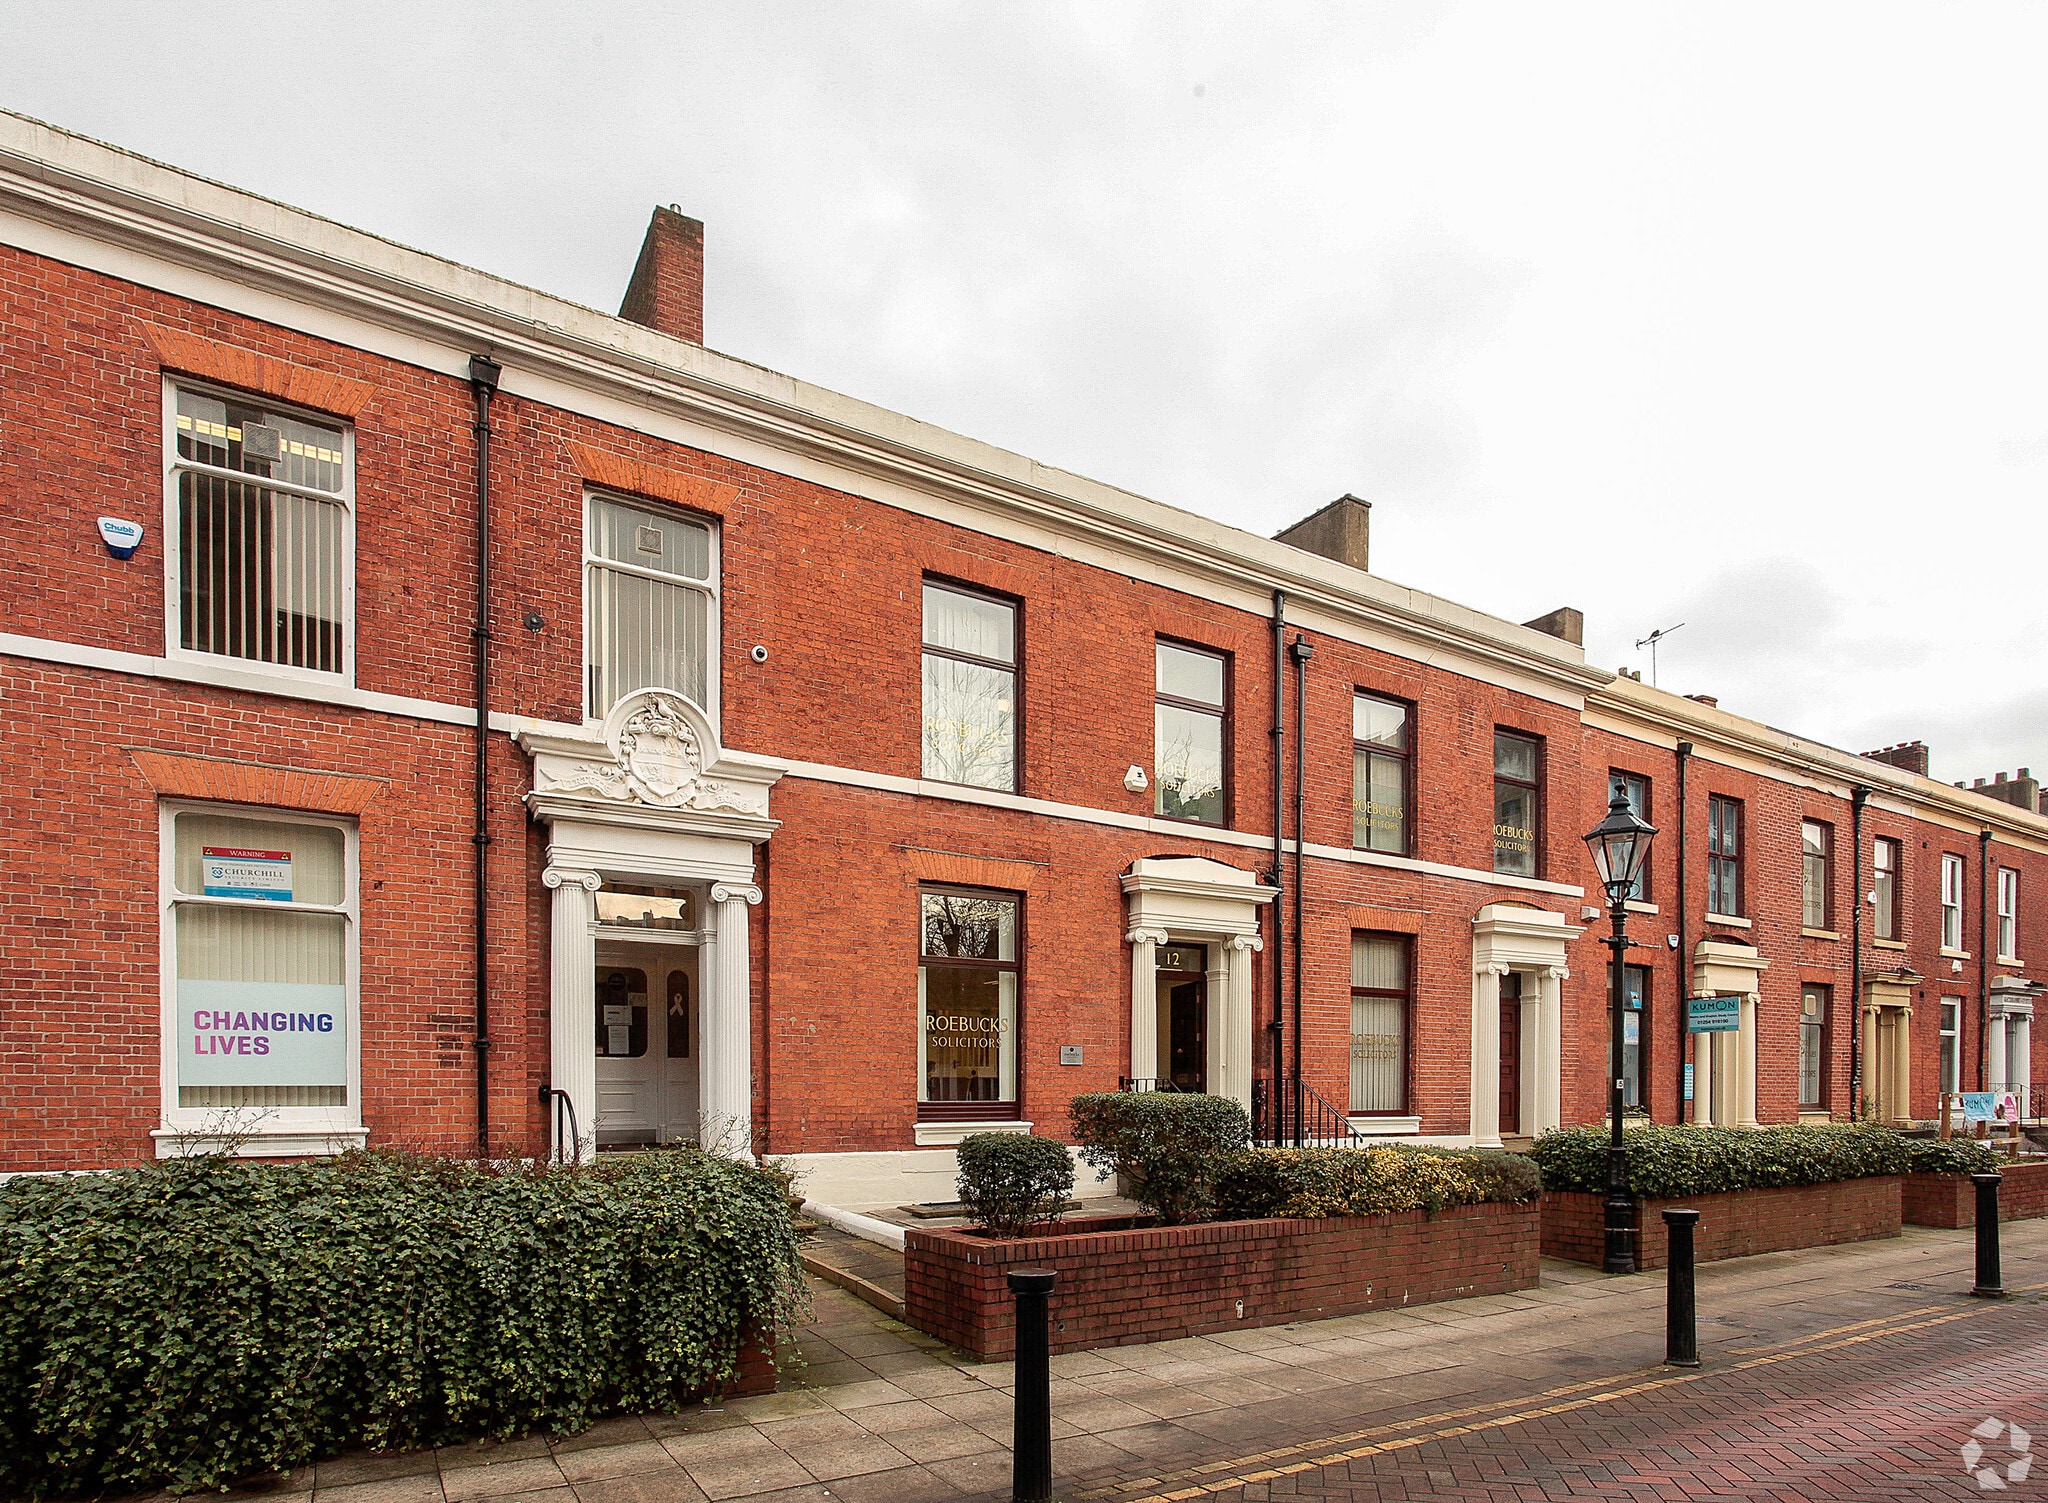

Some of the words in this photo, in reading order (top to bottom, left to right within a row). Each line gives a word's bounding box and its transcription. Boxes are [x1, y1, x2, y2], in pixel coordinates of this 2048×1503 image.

[104, 522, 135, 533] Chubb
[926, 715, 1008, 745] ROEBUCKS
[932, 738, 1002, 759] SOLICITORS
[1353, 798, 1404, 819] ROEBUCKS
[1356, 815, 1399, 832] SOLICITORS
[229, 849, 266, 858] WARNING
[224, 868, 285, 878] CHURCHILL
[1166, 952, 1180, 966] 12
[1692, 1000, 1736, 1011] KUMON
[193, 1010, 334, 1033] CHANGING
[926, 1015, 1009, 1033] ROEBUCKS
[194, 1035, 271, 1056] LIVES
[932, 1036, 1003, 1049] SOLICITORS
[1350, 1033, 1402, 1047] ROEBUCKS
[1353, 1050, 1397, 1060] SOLICITORS
